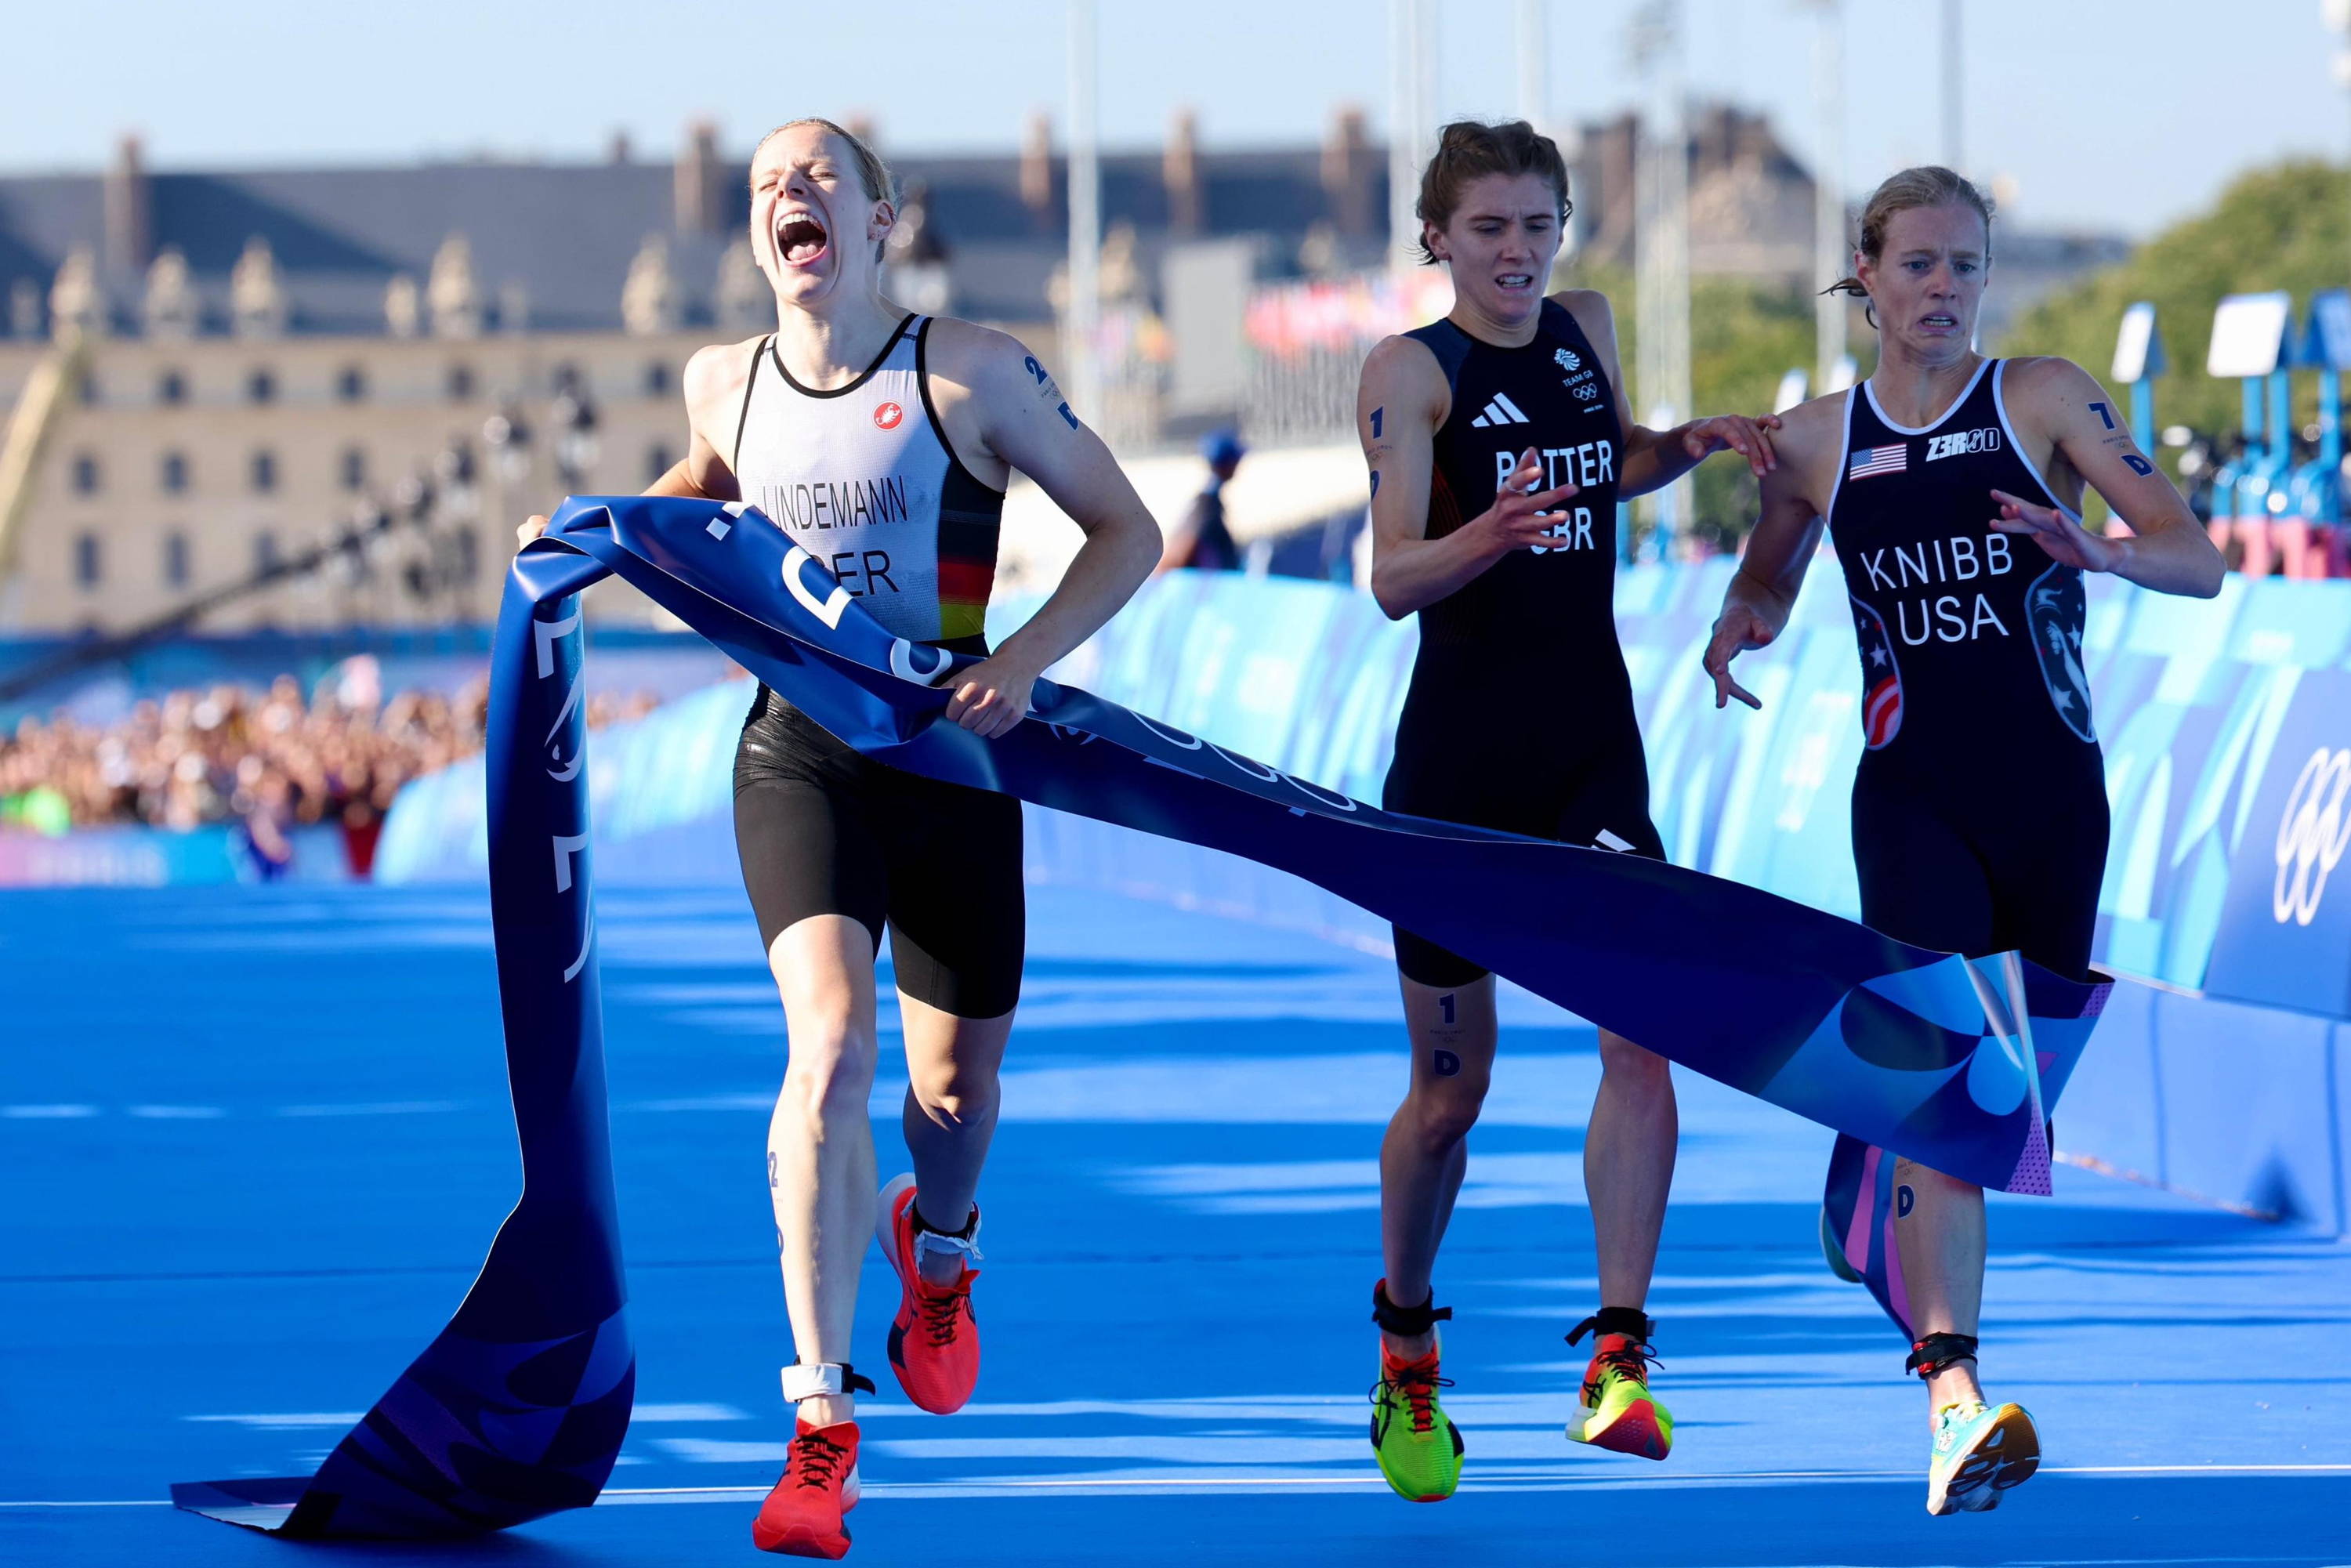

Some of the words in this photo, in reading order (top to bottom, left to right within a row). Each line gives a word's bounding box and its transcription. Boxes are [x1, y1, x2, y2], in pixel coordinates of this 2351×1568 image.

[1024, 356, 1048, 386] 2
[1562, 373, 1585, 387] TEAM
[1369, 406, 1384, 440] 1
[2120, 454, 2154, 476] D
[812, 549, 900, 598] ER
[1860, 532, 2014, 592] KNIBB
[1897, 592, 2009, 646] USA
[1439, 993, 1455, 1024] 1
[1434, 1048, 1461, 1077] D
[1897, 1184, 1915, 1219] D
